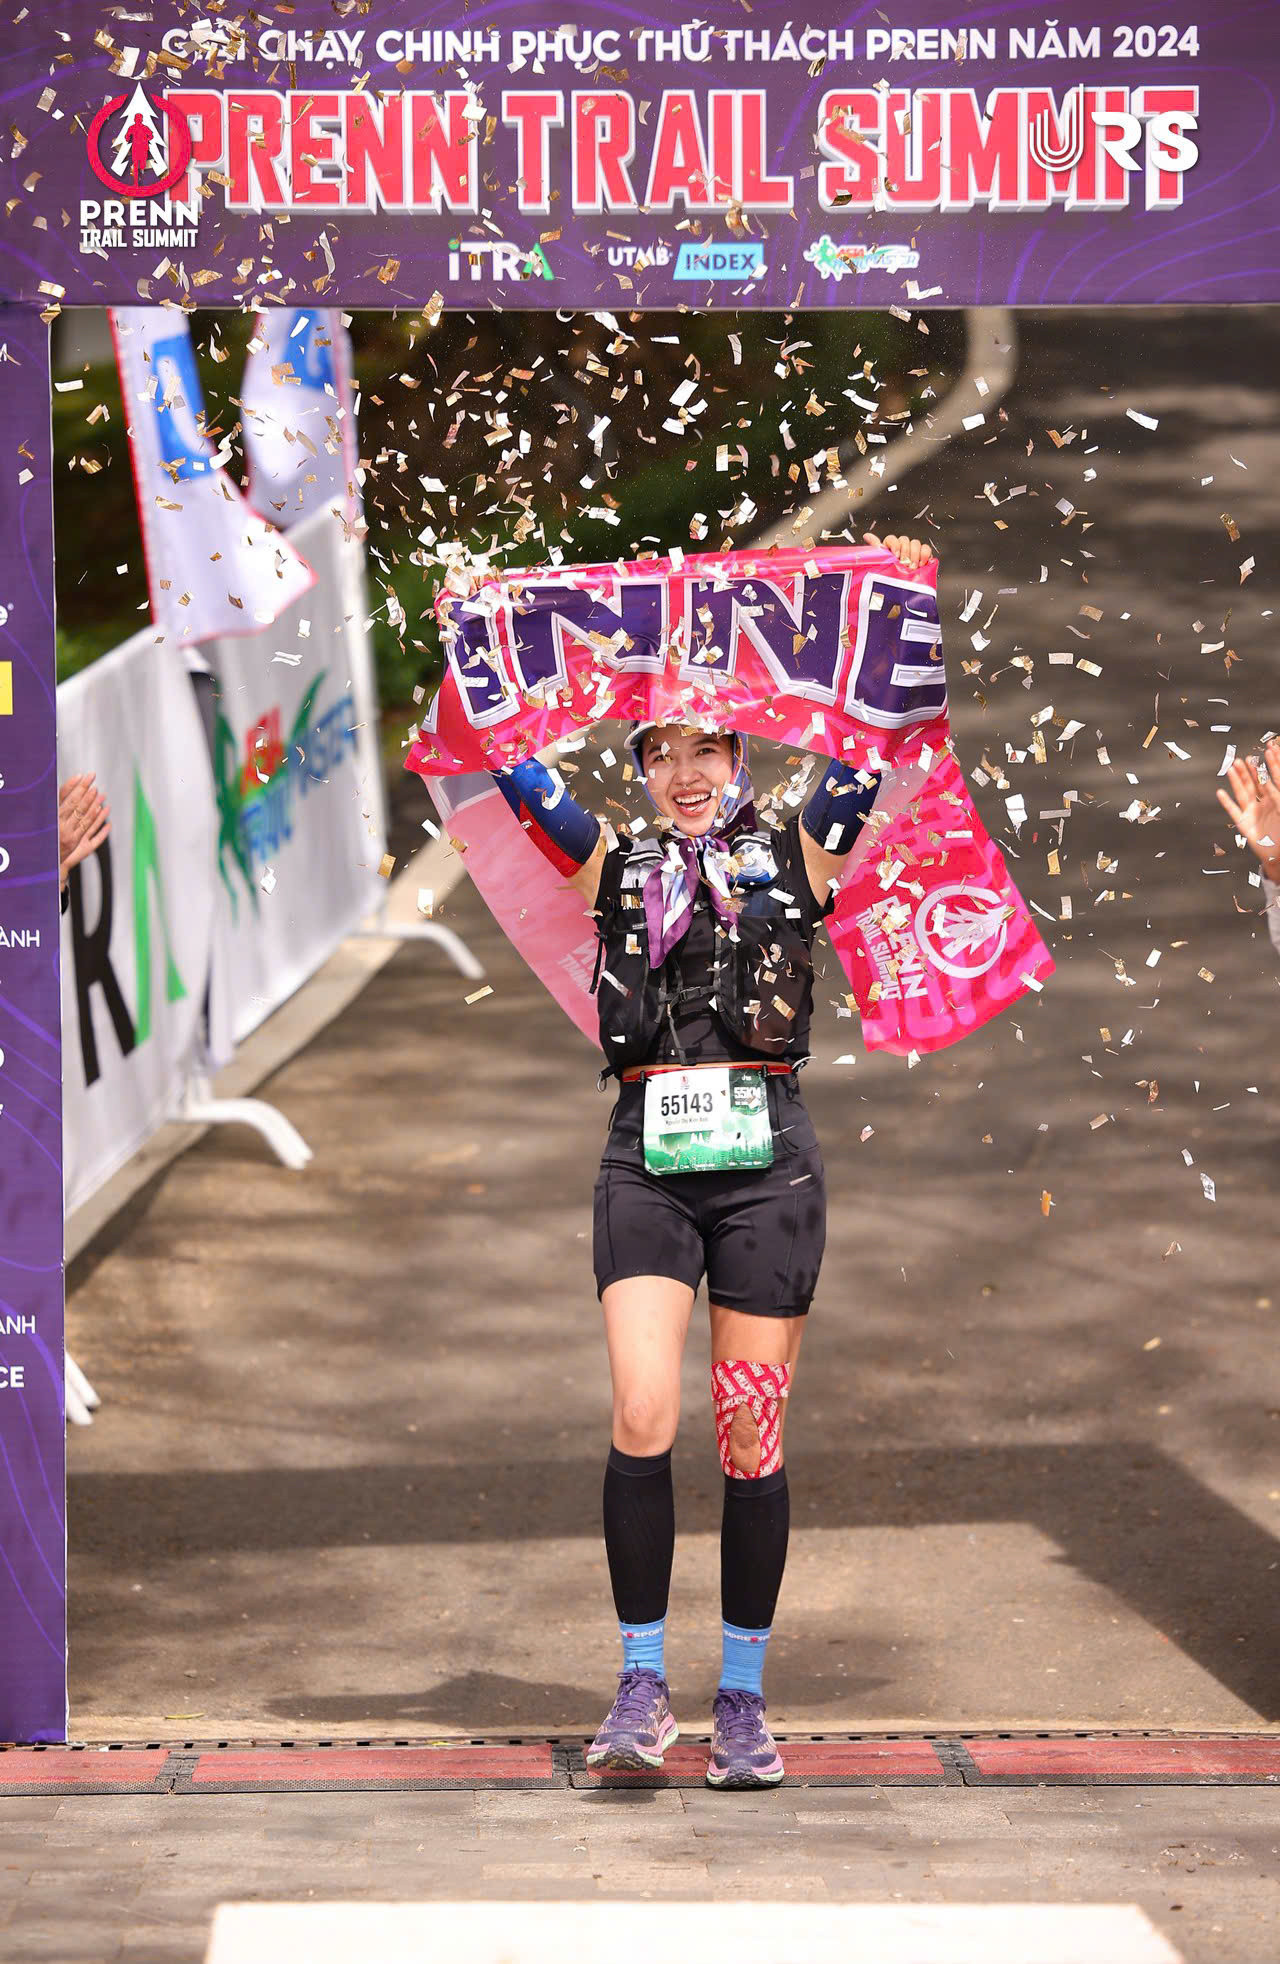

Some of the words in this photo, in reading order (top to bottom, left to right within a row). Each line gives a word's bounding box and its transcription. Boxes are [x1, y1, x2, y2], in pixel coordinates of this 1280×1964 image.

[257, 30, 366, 70] CHẠY
[375, 30, 500, 62] CHINH
[512, 30, 622, 71] PHỤC
[724, 21, 854, 61] THÁCH
[867, 28, 996, 60] PRENN
[1009, 19, 1101, 59] NĂM
[1113, 25, 1200, 57] 2024
[163, 88, 479, 215] PRENN
[501, 89, 794, 215] TRAIL
[818, 85, 1199, 213] SUMMIT
[607, 247, 670, 266] UTMB
[686, 254, 755, 271] INDEX
[661, 1092, 713, 1117] 55143
